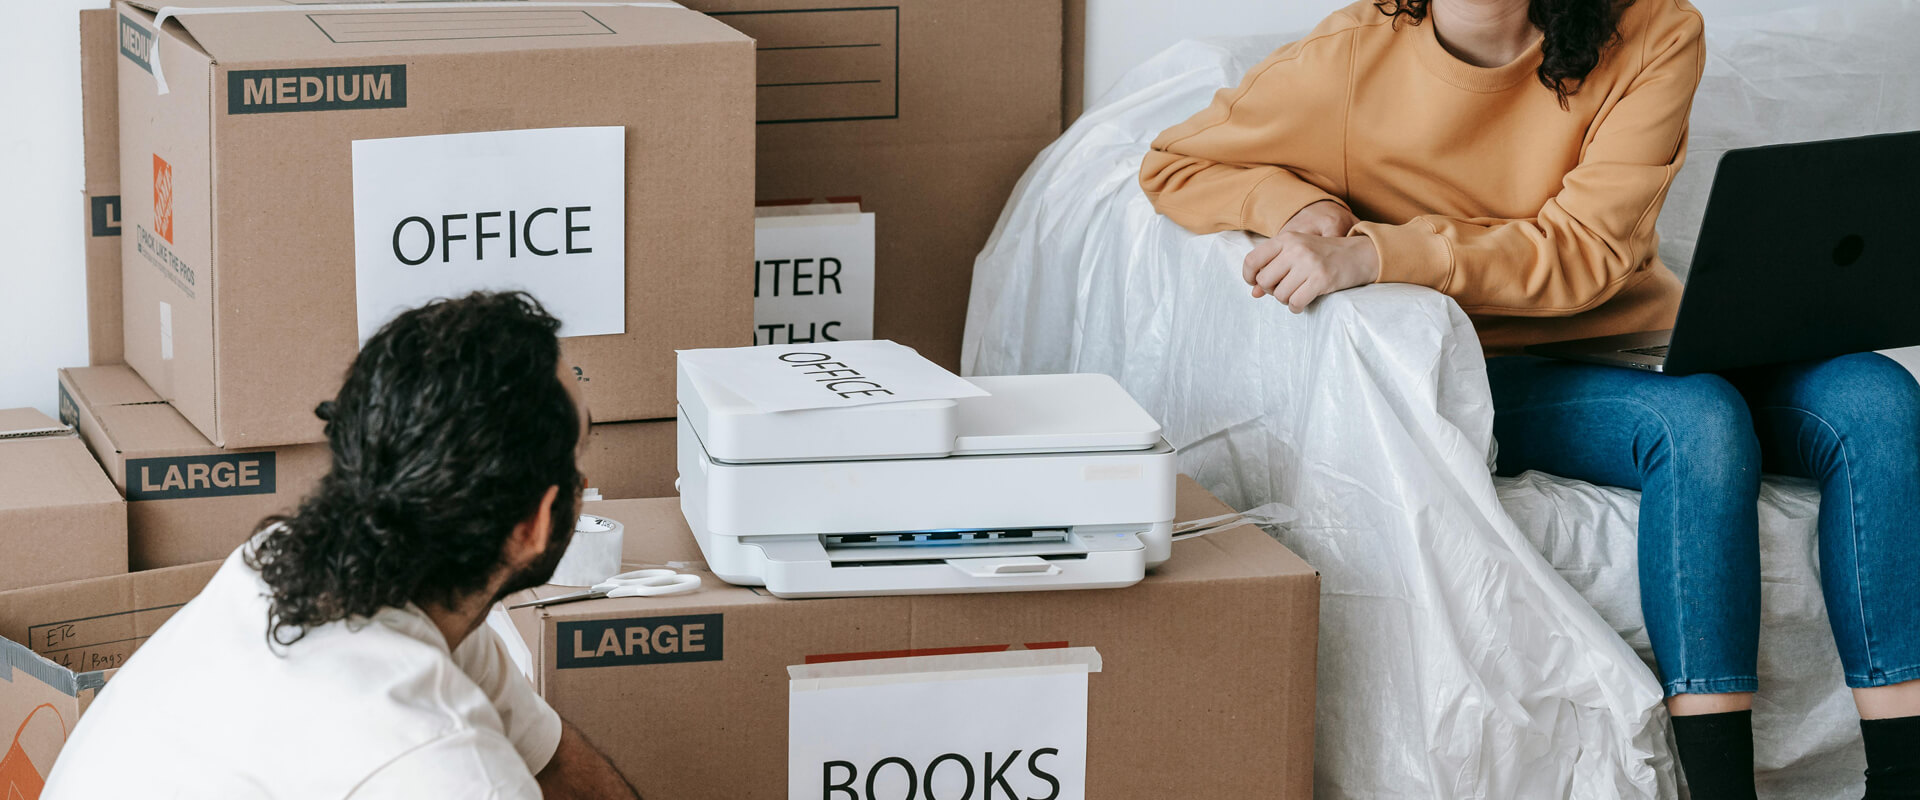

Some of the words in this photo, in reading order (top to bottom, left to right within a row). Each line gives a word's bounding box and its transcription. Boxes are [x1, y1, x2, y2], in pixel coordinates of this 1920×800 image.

[123, 22, 151, 65] MEDIU
[243, 73, 392, 105] MEDIUM
[392, 206, 593, 266] OFFICE
[168, 250, 179, 273] THE
[778, 352, 895, 399] OFFICE
[141, 460, 260, 492] LARGE
[47, 624, 76, 647] ETC
[574, 623, 705, 659] LARGE
[92, 653, 123, 669] Bags
[823, 747, 1060, 800] BOOKS
